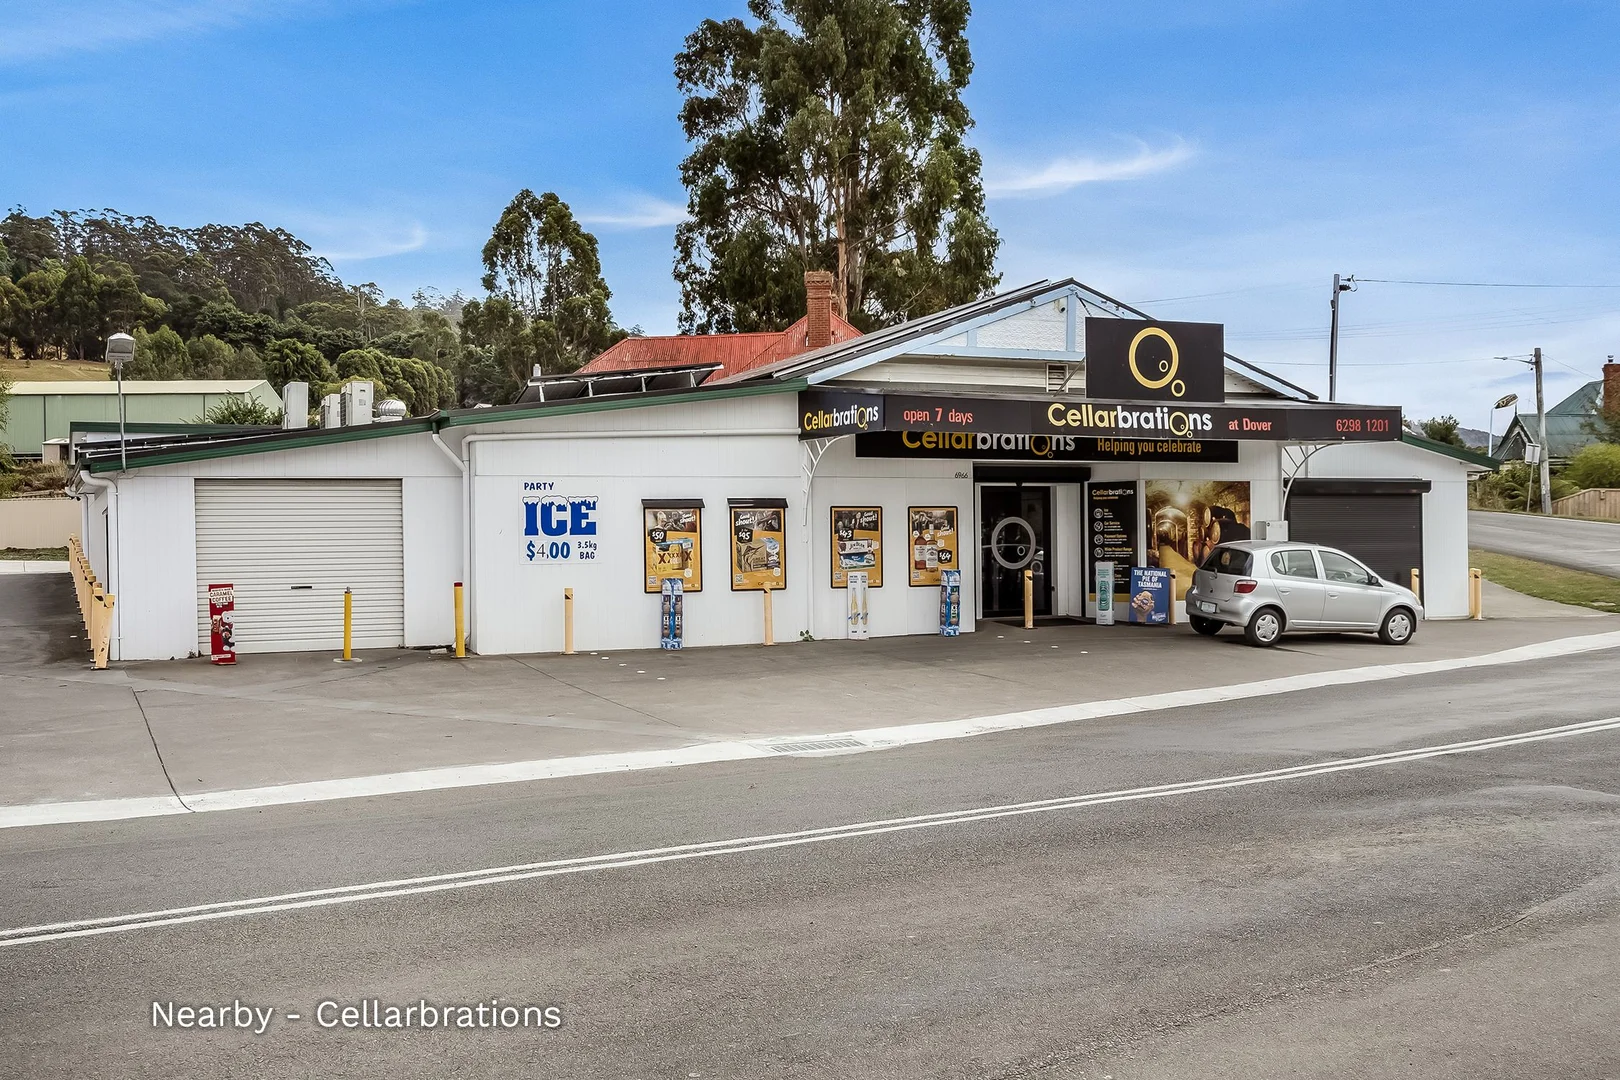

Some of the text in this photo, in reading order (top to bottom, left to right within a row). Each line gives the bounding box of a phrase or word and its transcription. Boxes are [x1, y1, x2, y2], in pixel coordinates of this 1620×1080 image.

[804, 404, 879, 431] Cellarbrations
[903, 407, 974, 425] open 7 days
[1047, 402, 1213, 437] Cellarbrations
[1228, 417, 1273, 432] at Dover
[1335, 418, 1390, 432] 6298 1201
[1097, 438, 1202, 456] Helping you celebrate
[523, 482, 555, 491] PARTY
[522, 495, 599, 537] ICE
[652, 531, 665, 540] $50
[577, 541, 598, 551] 3.5kg
[579, 551, 596, 560] BAG
[1133, 569, 1168, 578] THE NATIONAL
[1137, 580, 1163, 589] TASMANIA
[209, 590, 234, 598] CARAMEL
[211, 595, 232, 603] COFFEE
